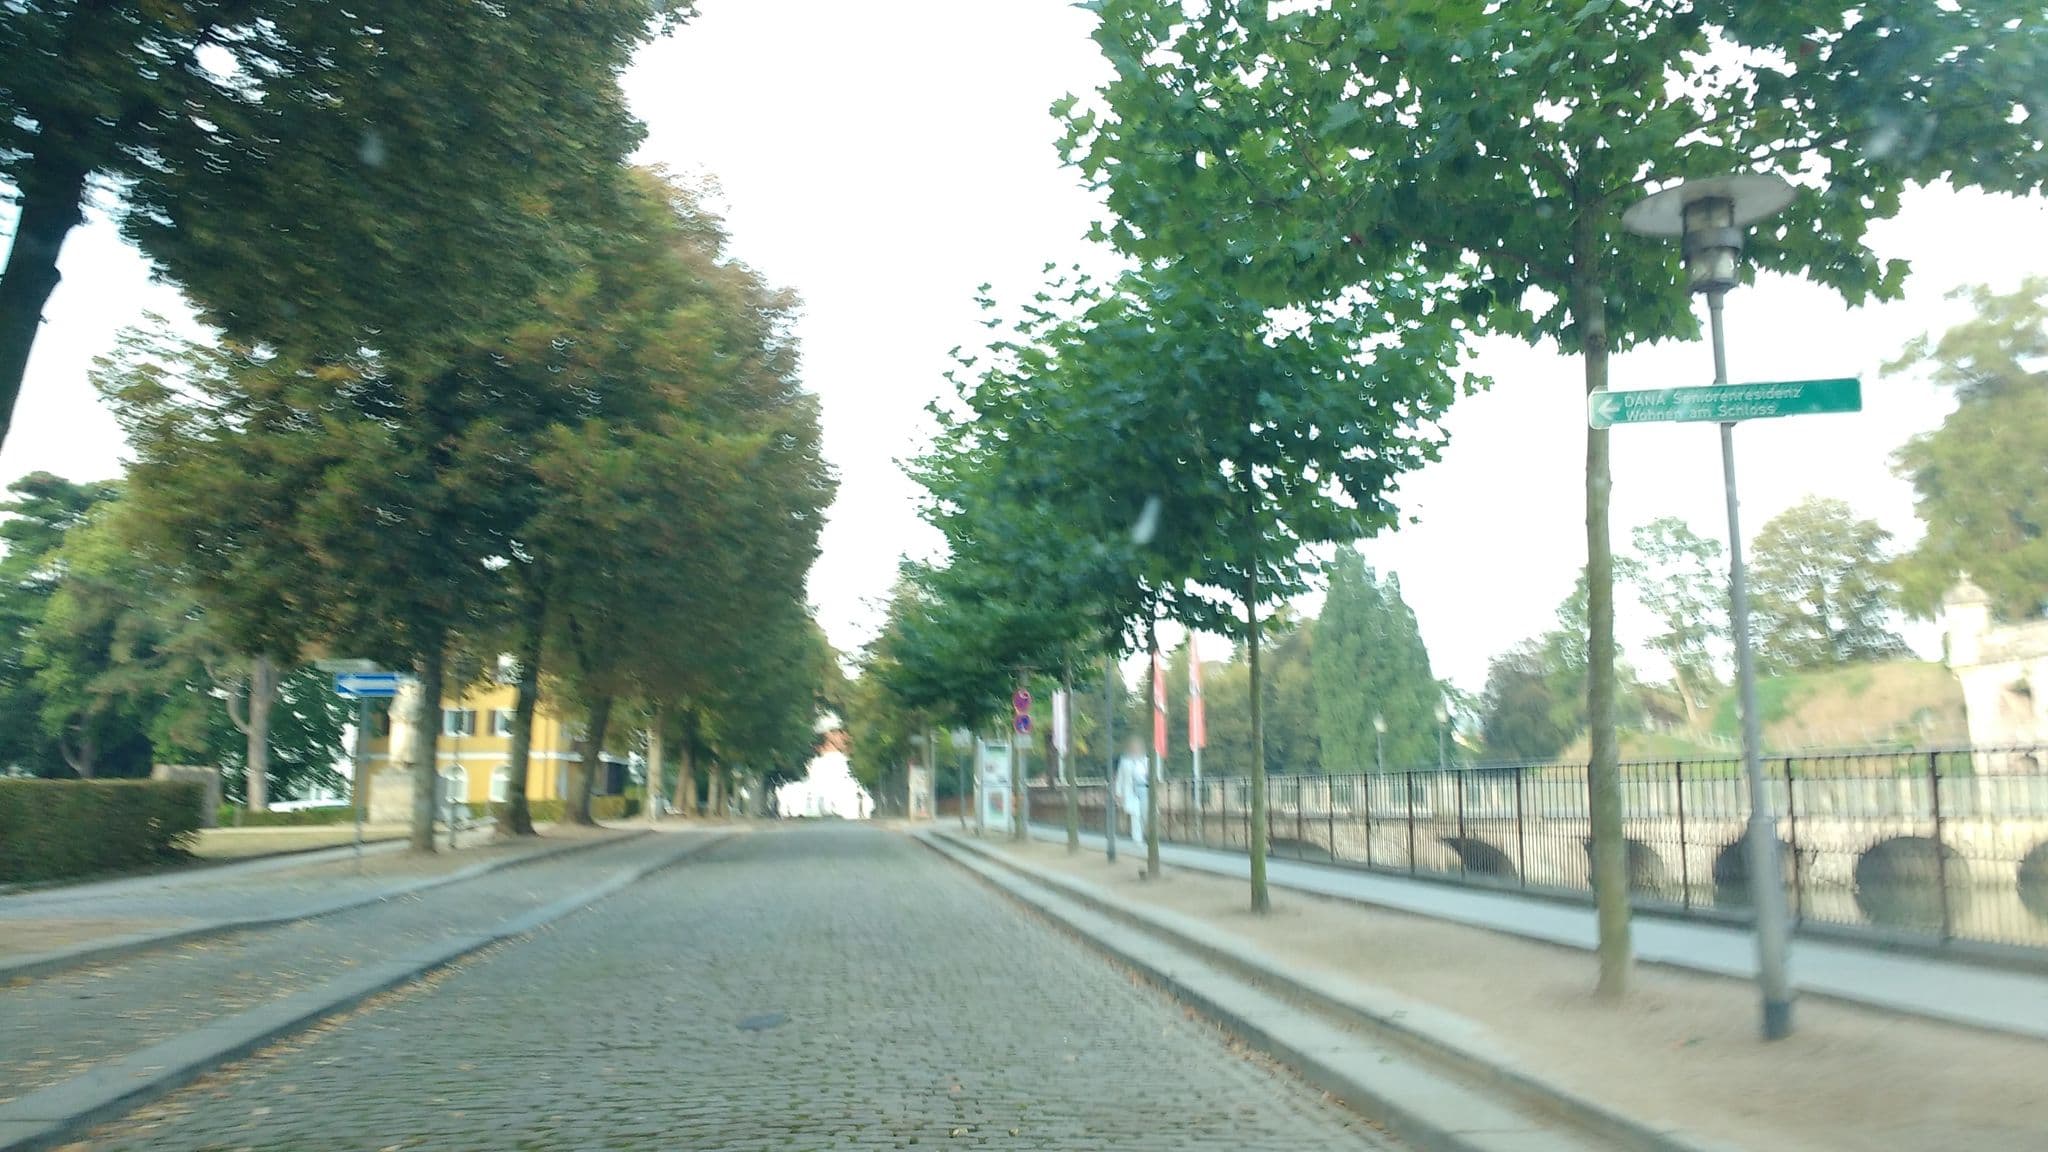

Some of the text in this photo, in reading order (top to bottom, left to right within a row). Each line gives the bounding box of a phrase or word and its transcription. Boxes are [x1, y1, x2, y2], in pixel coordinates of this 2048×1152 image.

[1624, 385, 1802, 408] DANA Seniorenresidenz
[1625, 404, 1775, 421] Wohnen am Schloss
